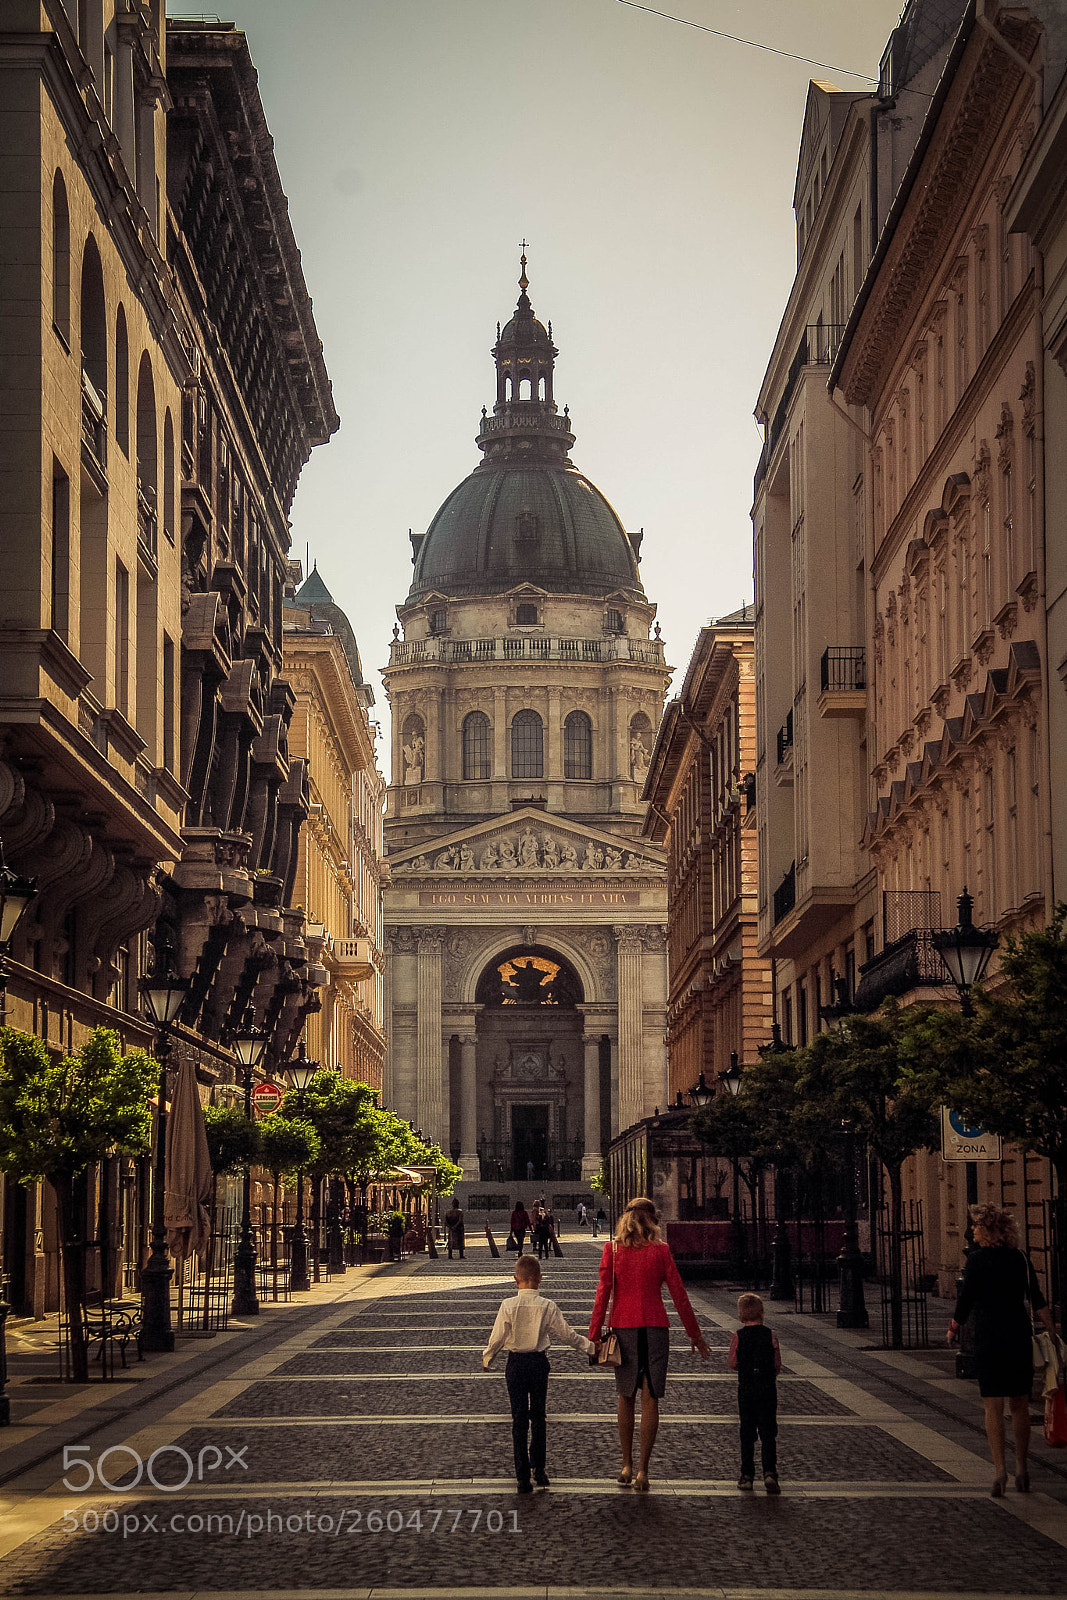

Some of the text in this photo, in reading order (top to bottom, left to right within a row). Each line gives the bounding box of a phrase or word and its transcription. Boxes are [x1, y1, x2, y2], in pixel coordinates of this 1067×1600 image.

[432, 894, 626, 904] EGO SUM VIA VERITAS ET VITA
[956, 1145, 987, 1153] ZONA
